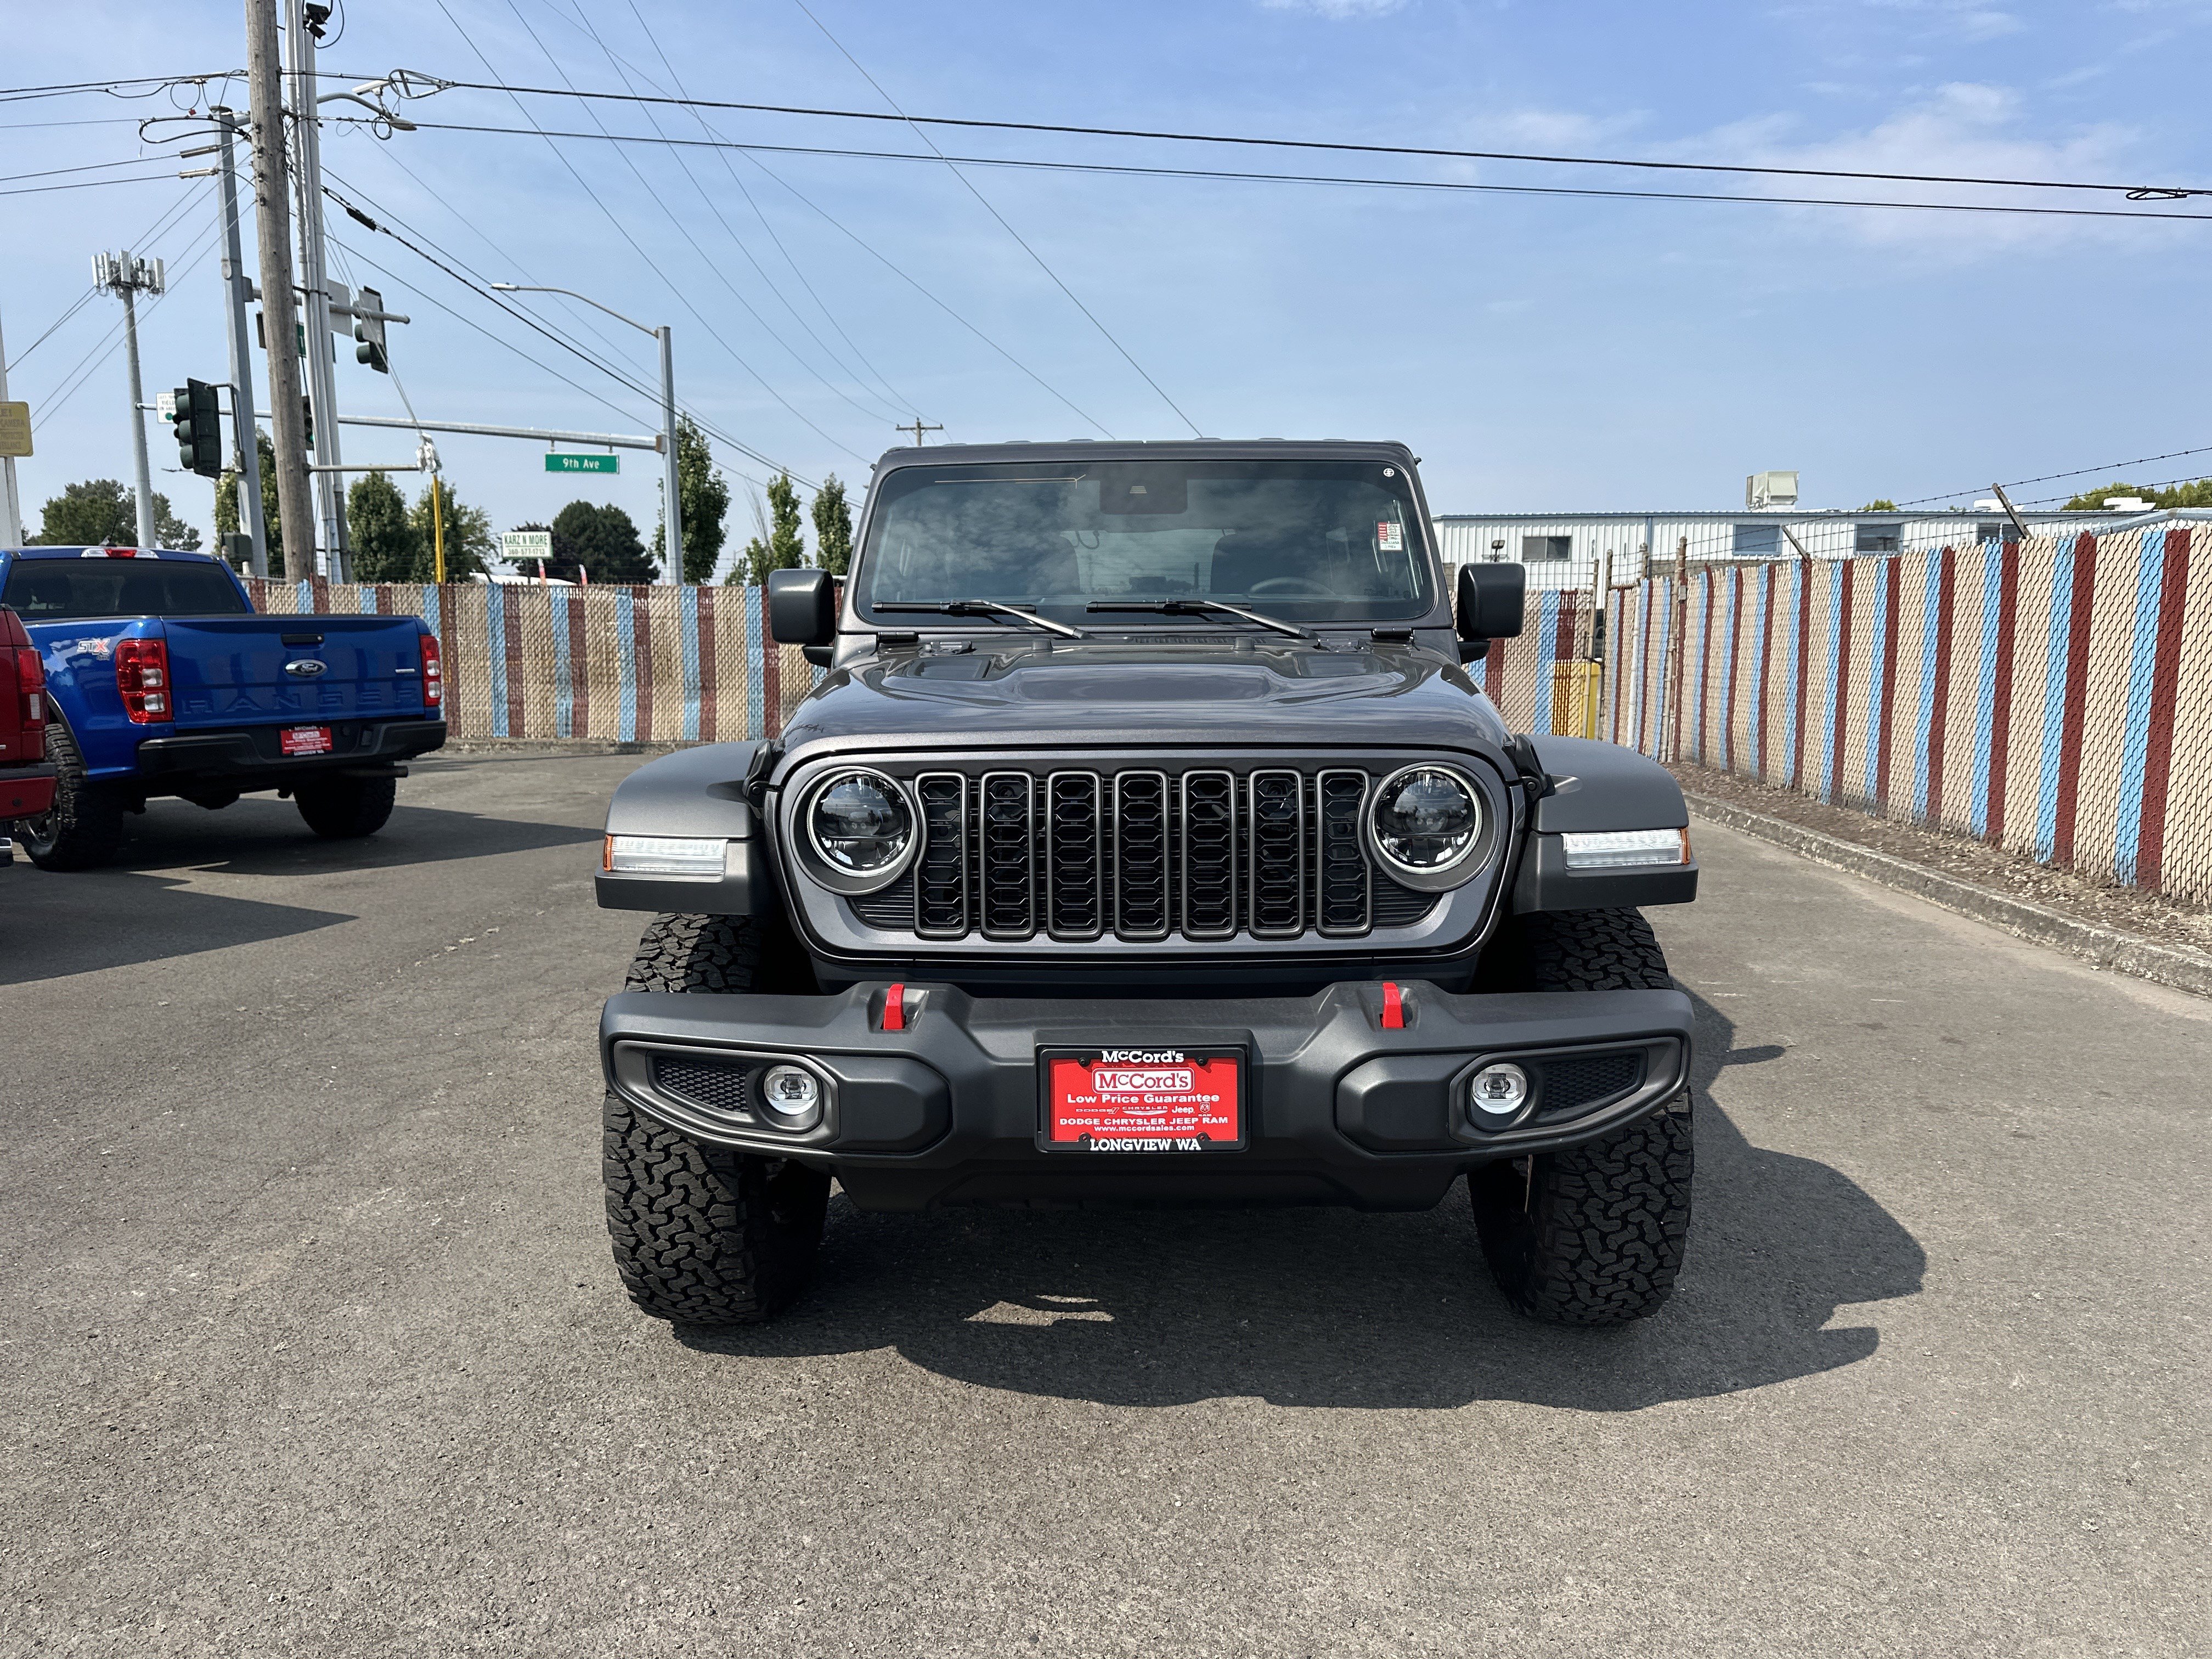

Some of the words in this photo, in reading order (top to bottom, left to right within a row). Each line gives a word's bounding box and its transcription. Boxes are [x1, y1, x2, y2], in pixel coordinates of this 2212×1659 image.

[562, 458, 579, 469] 9th
[583, 459, 600, 469] Ave
[504, 534, 521, 545] KARZ
[522, 534, 527, 544] N
[529, 534, 548, 545] MORE
[77, 639, 110, 655] STX
[182, 687, 417, 714] RANGER
[1102, 1050, 1184, 1063] McCord's
[1098, 1073, 1188, 1089] McCord's
[1067, 1094, 1097, 1103] Low
[1102, 1093, 1139, 1103] Price
[1143, 1093, 1220, 1103] Guarantee
[1171, 1105, 1195, 1115] Jeep
[1090, 1138, 1171, 1152] LONGVIEW
[1175, 1138, 1201, 1151] WA
